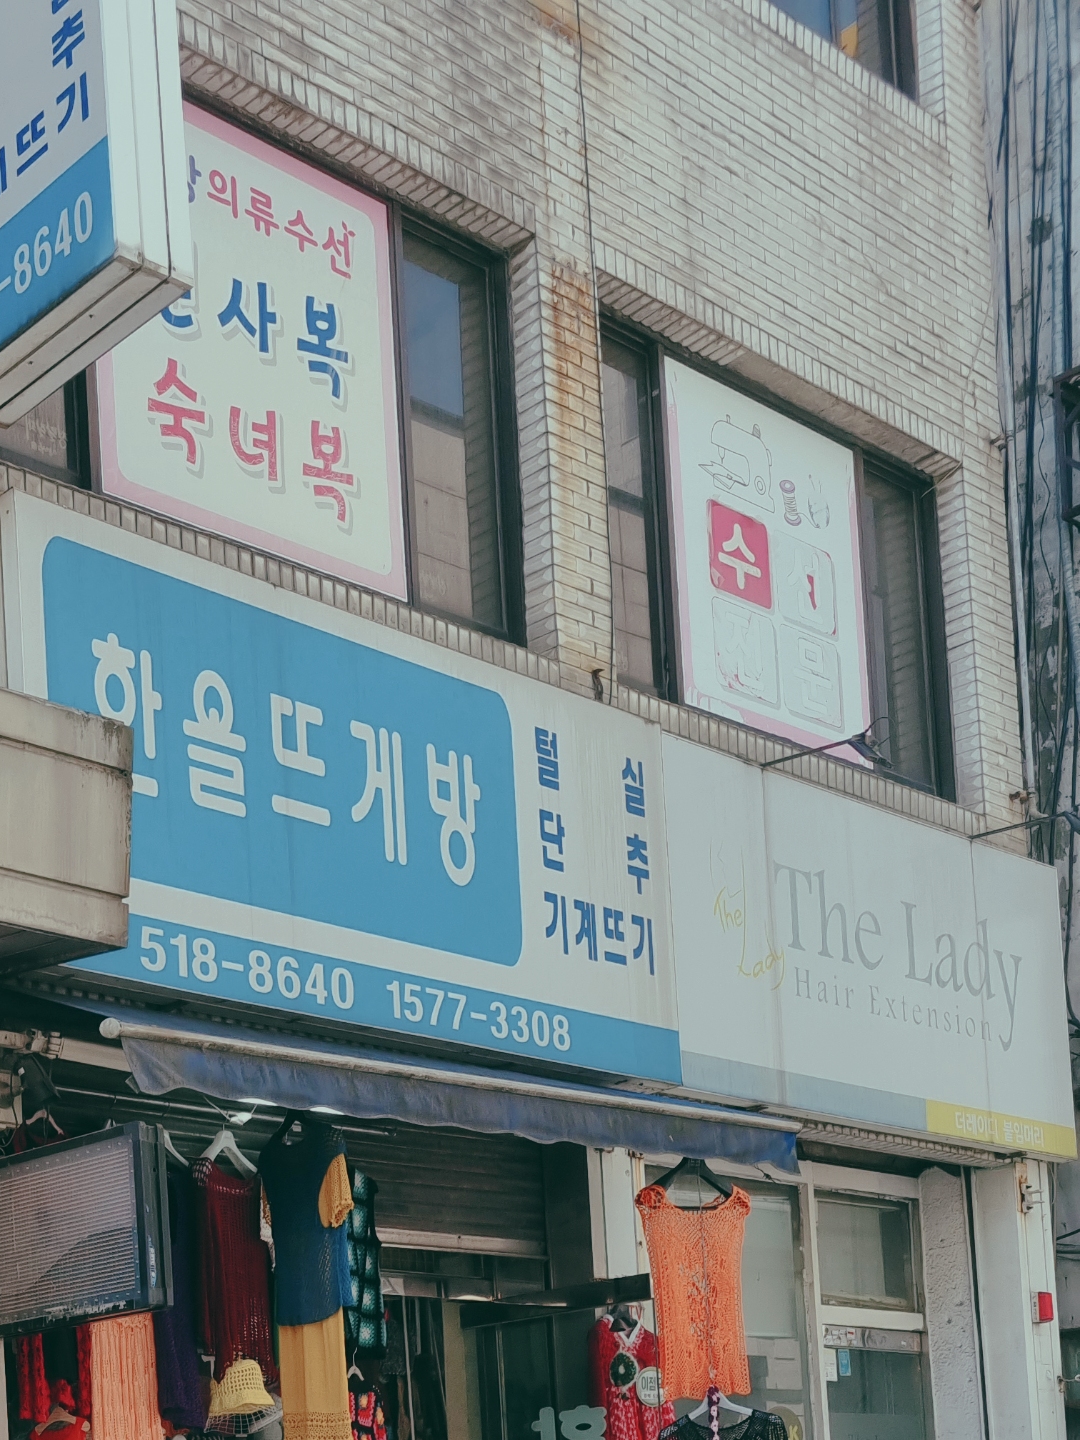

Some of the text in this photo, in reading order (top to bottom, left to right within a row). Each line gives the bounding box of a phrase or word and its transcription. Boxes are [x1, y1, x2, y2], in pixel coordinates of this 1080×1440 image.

[147, 358, 355, 523] 숙녀복
[91, 632, 481, 886] 한올뜨게방
[139, 925, 572, 1051] 518-8640 1577-3308
[544, 891, 656, 976] 기계뜨기
[773, 860, 1022, 1052] The Lady
[794, 966, 993, 1042] Hair Extension
[954, 1111, 999, 1140] 더레이디
